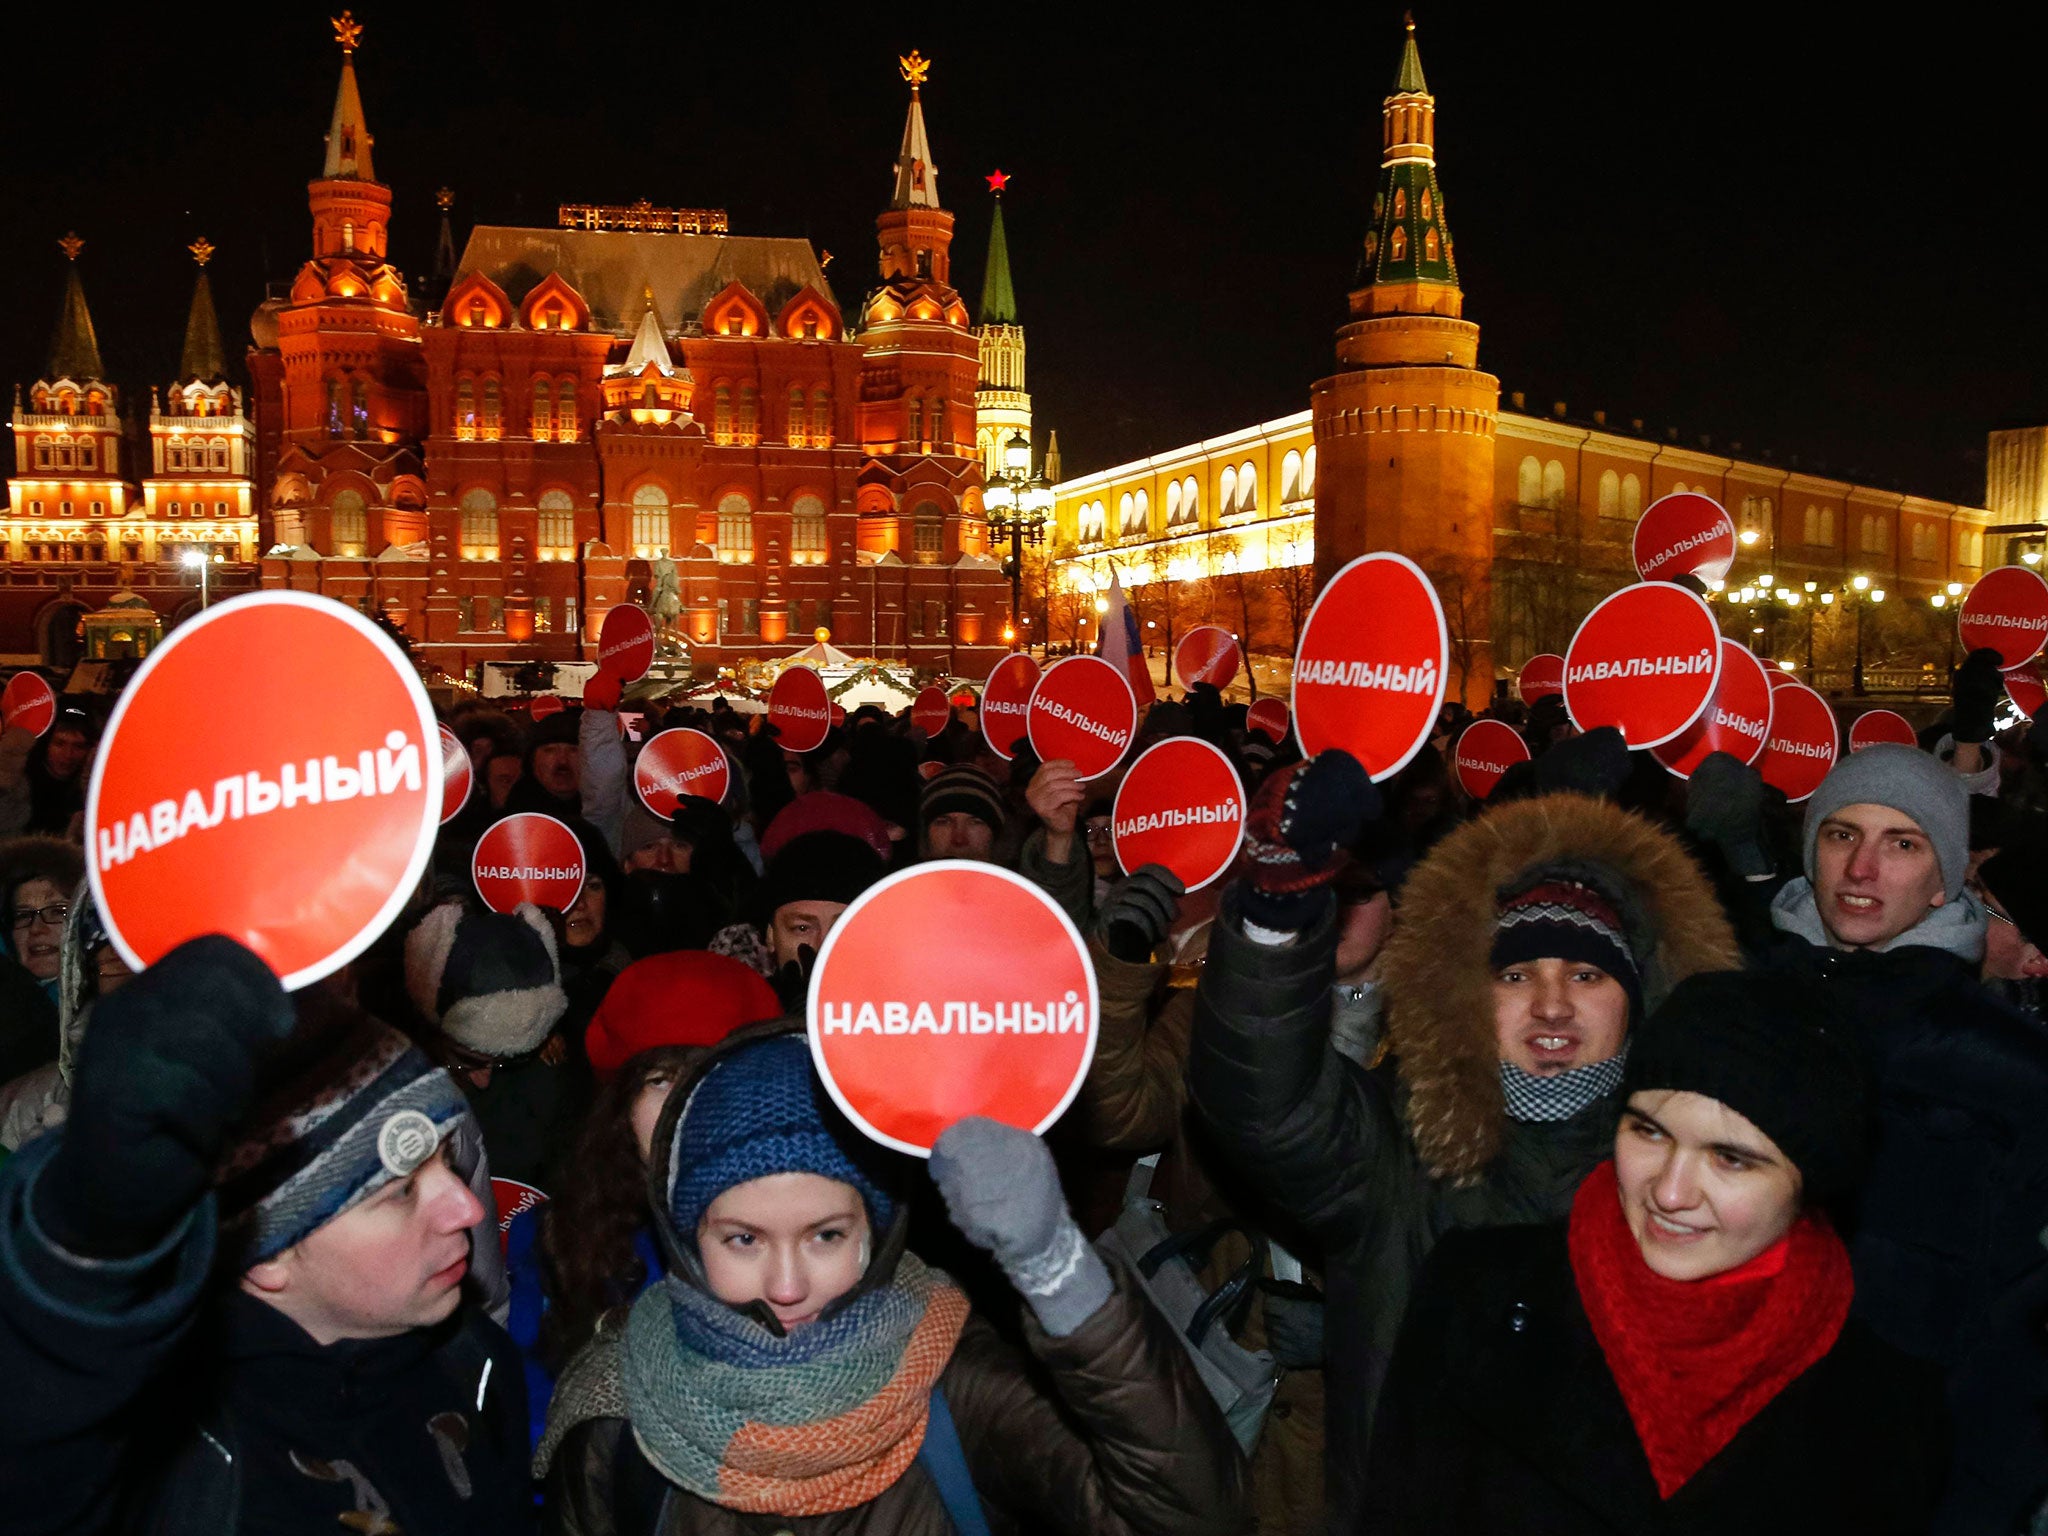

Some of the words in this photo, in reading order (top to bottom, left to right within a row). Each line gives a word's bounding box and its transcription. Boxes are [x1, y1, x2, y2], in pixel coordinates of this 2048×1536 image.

[1640, 519, 1730, 576] НАВАЛЬНЫЙ
[1960, 613, 2047, 631] НАВАЛЬНЫЙ
[1296, 658, 1436, 695] НАВАЛЬНЫЙ
[1567, 648, 1713, 684] НАВАЛЬНЫЙ
[984, 700, 1028, 716] НАВАЛ
[1033, 694, 1128, 748] НАВАЛЬНЫЙ
[1767, 737, 1833, 760] АЛЬНЫЙ
[641, 757, 725, 796] НАВАЛЬНЫЙ
[99, 730, 421, 871] НАВАЛЬНЫЙ
[1116, 799, 1239, 838] НАВАЛЬНЫЙ
[477, 864, 580, 880] НАВАЛЬНЫЙ
[823, 990, 1086, 1035] НАВАЛЬНЫЙ
